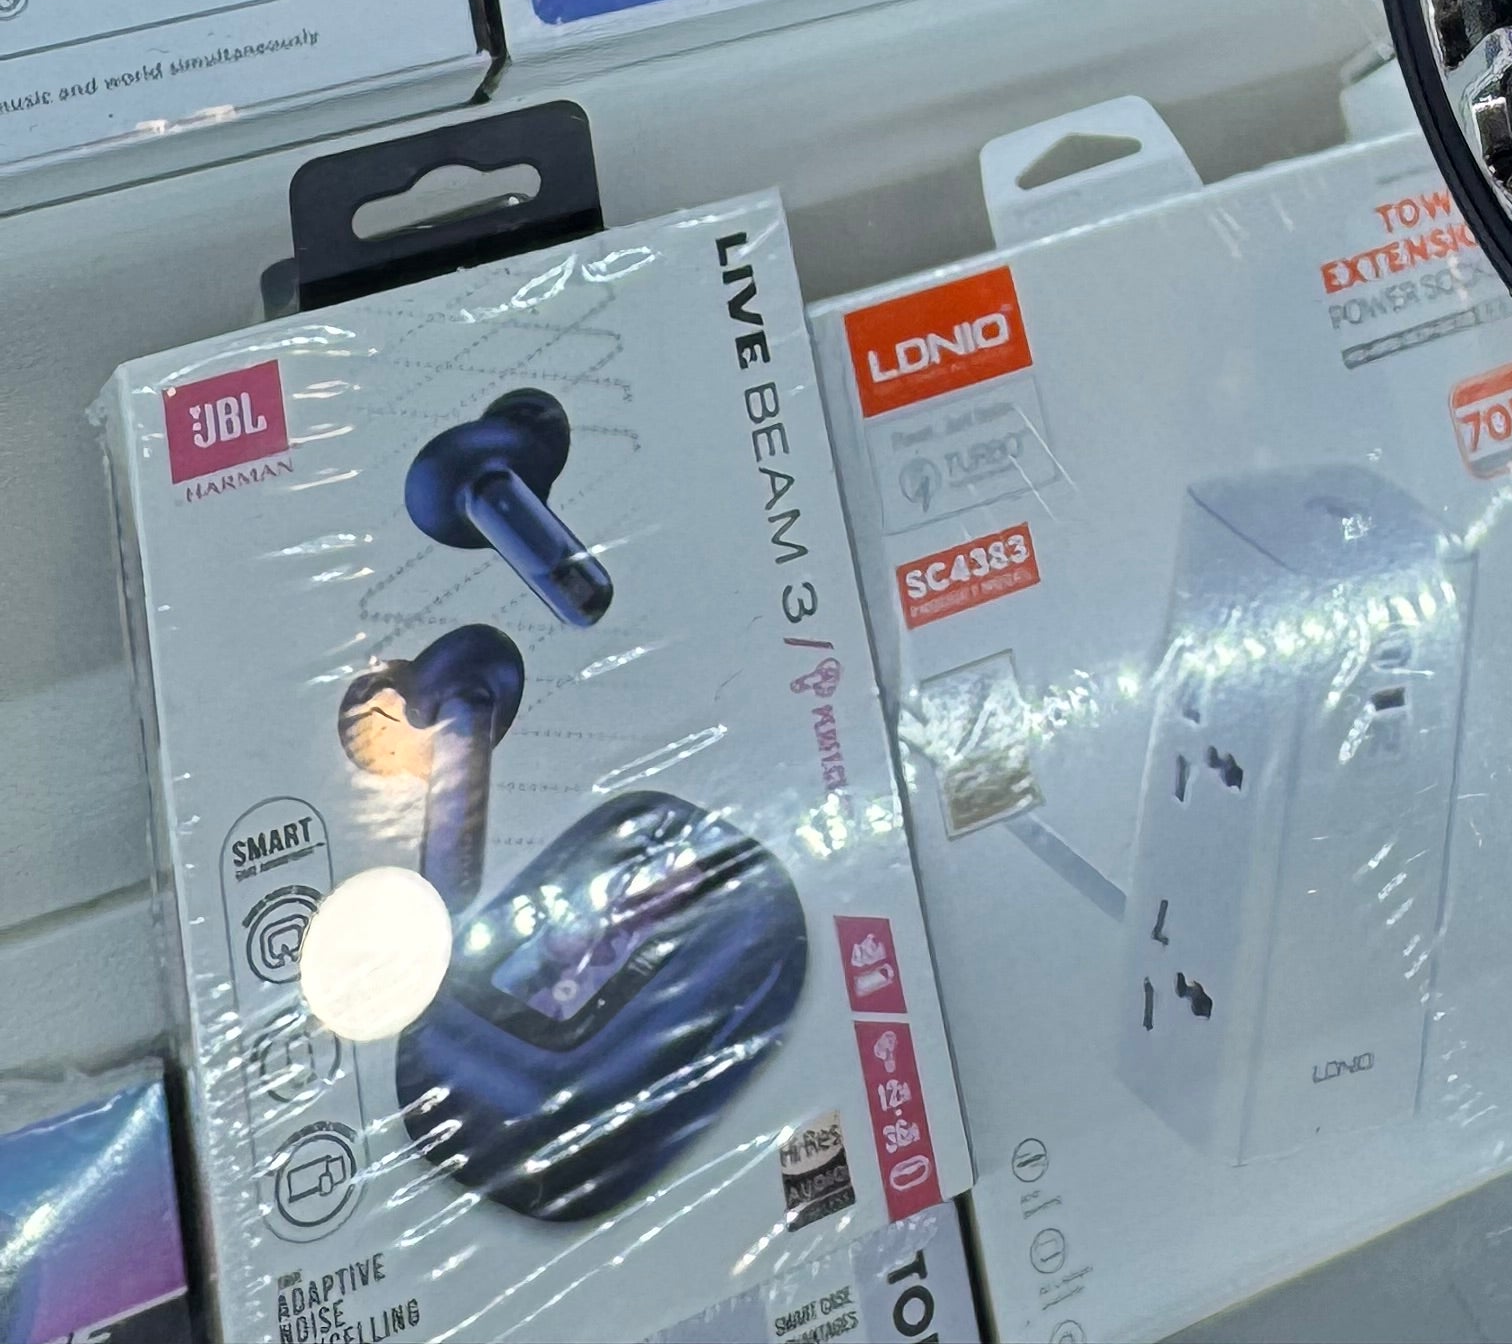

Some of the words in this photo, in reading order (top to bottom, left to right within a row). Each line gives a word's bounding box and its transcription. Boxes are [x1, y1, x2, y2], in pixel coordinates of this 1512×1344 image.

[59, 78, 98, 102] and
[867, 312, 1010, 383] LDNIO
[190, 391, 268, 448] JBL
[716, 232, 771, 370] LIVE
[744, 381, 809, 565] BEAM
[186, 458, 294, 503] HARMAN
[905, 534, 1030, 599] SC4383
[232, 817, 313, 867] SMART
[278, 1253, 387, 1322] ADAPTIVE
